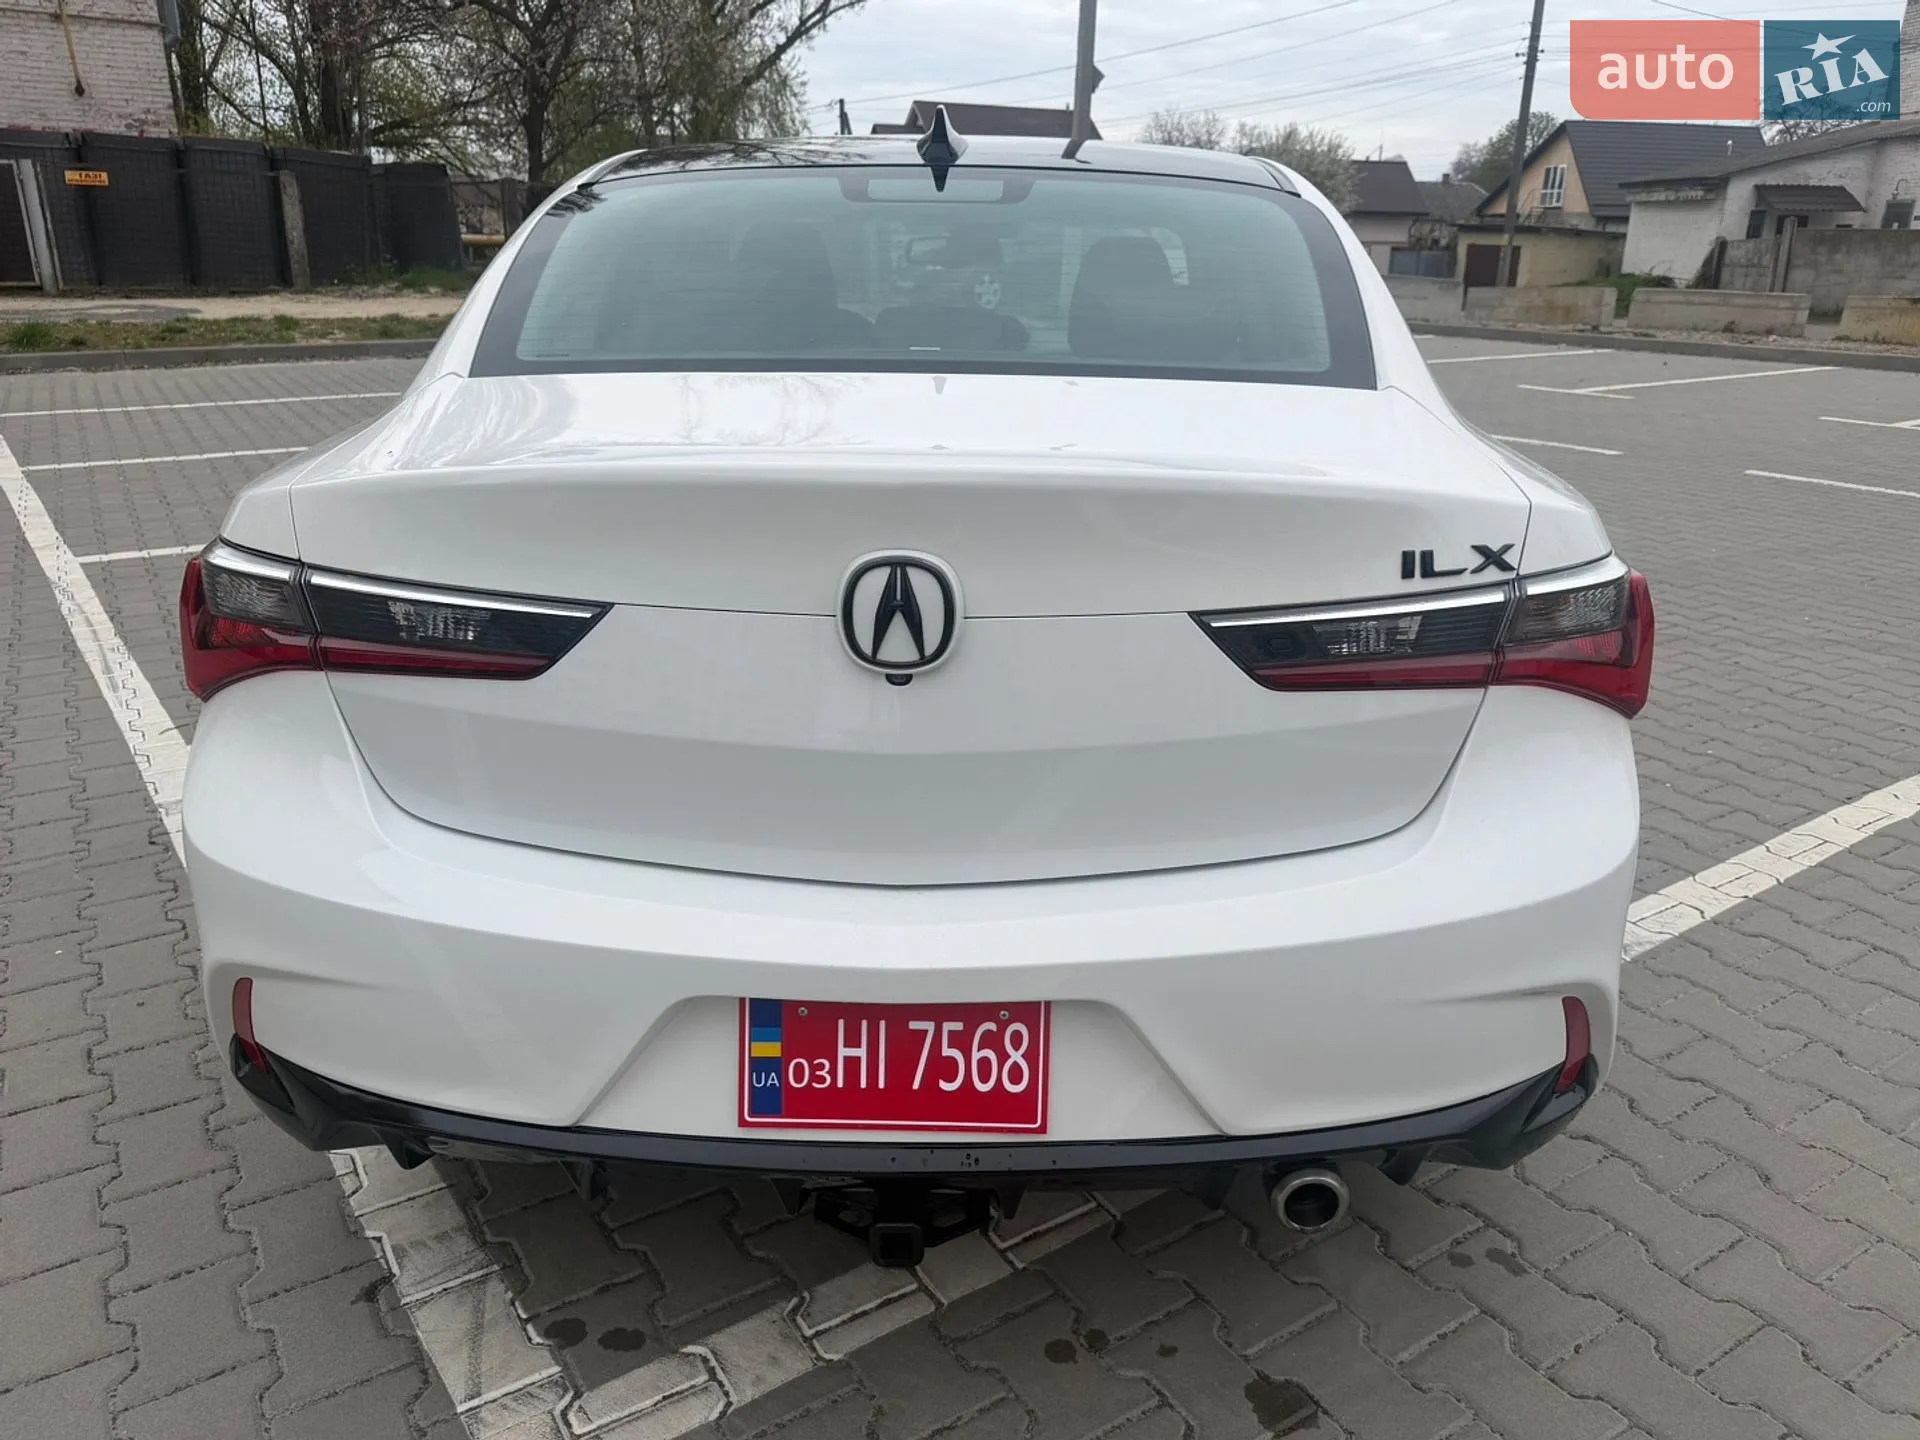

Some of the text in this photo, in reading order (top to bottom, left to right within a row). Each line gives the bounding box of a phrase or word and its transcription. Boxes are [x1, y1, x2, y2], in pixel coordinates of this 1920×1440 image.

[1401, 543, 1517, 579] ILX
[908, 1020, 1030, 1094] 7568
[752, 1072, 780, 1088] UA
